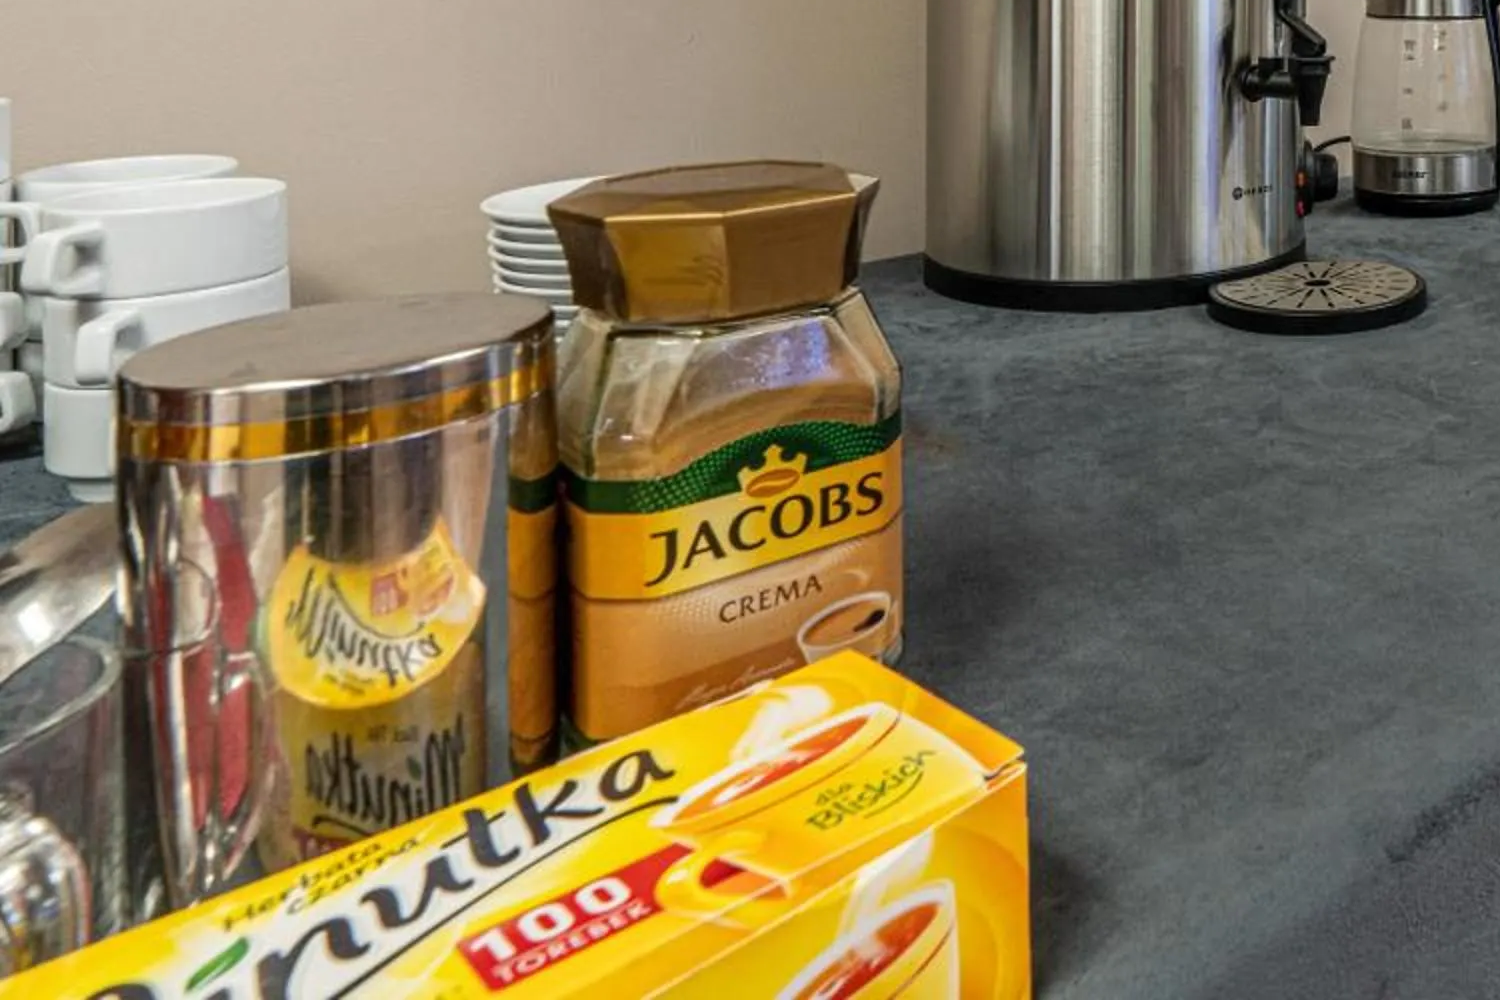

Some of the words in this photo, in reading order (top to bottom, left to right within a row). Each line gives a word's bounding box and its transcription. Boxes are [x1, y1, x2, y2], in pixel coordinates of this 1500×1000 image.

[644, 471, 884, 588] JACOBS
[718, 573, 823, 624] CREMA
[805, 749, 938, 830] Bliskich
[82, 748, 676, 1000] inutka
[468, 876, 632, 962] 100
[490, 897, 652, 983] TOREBEK
